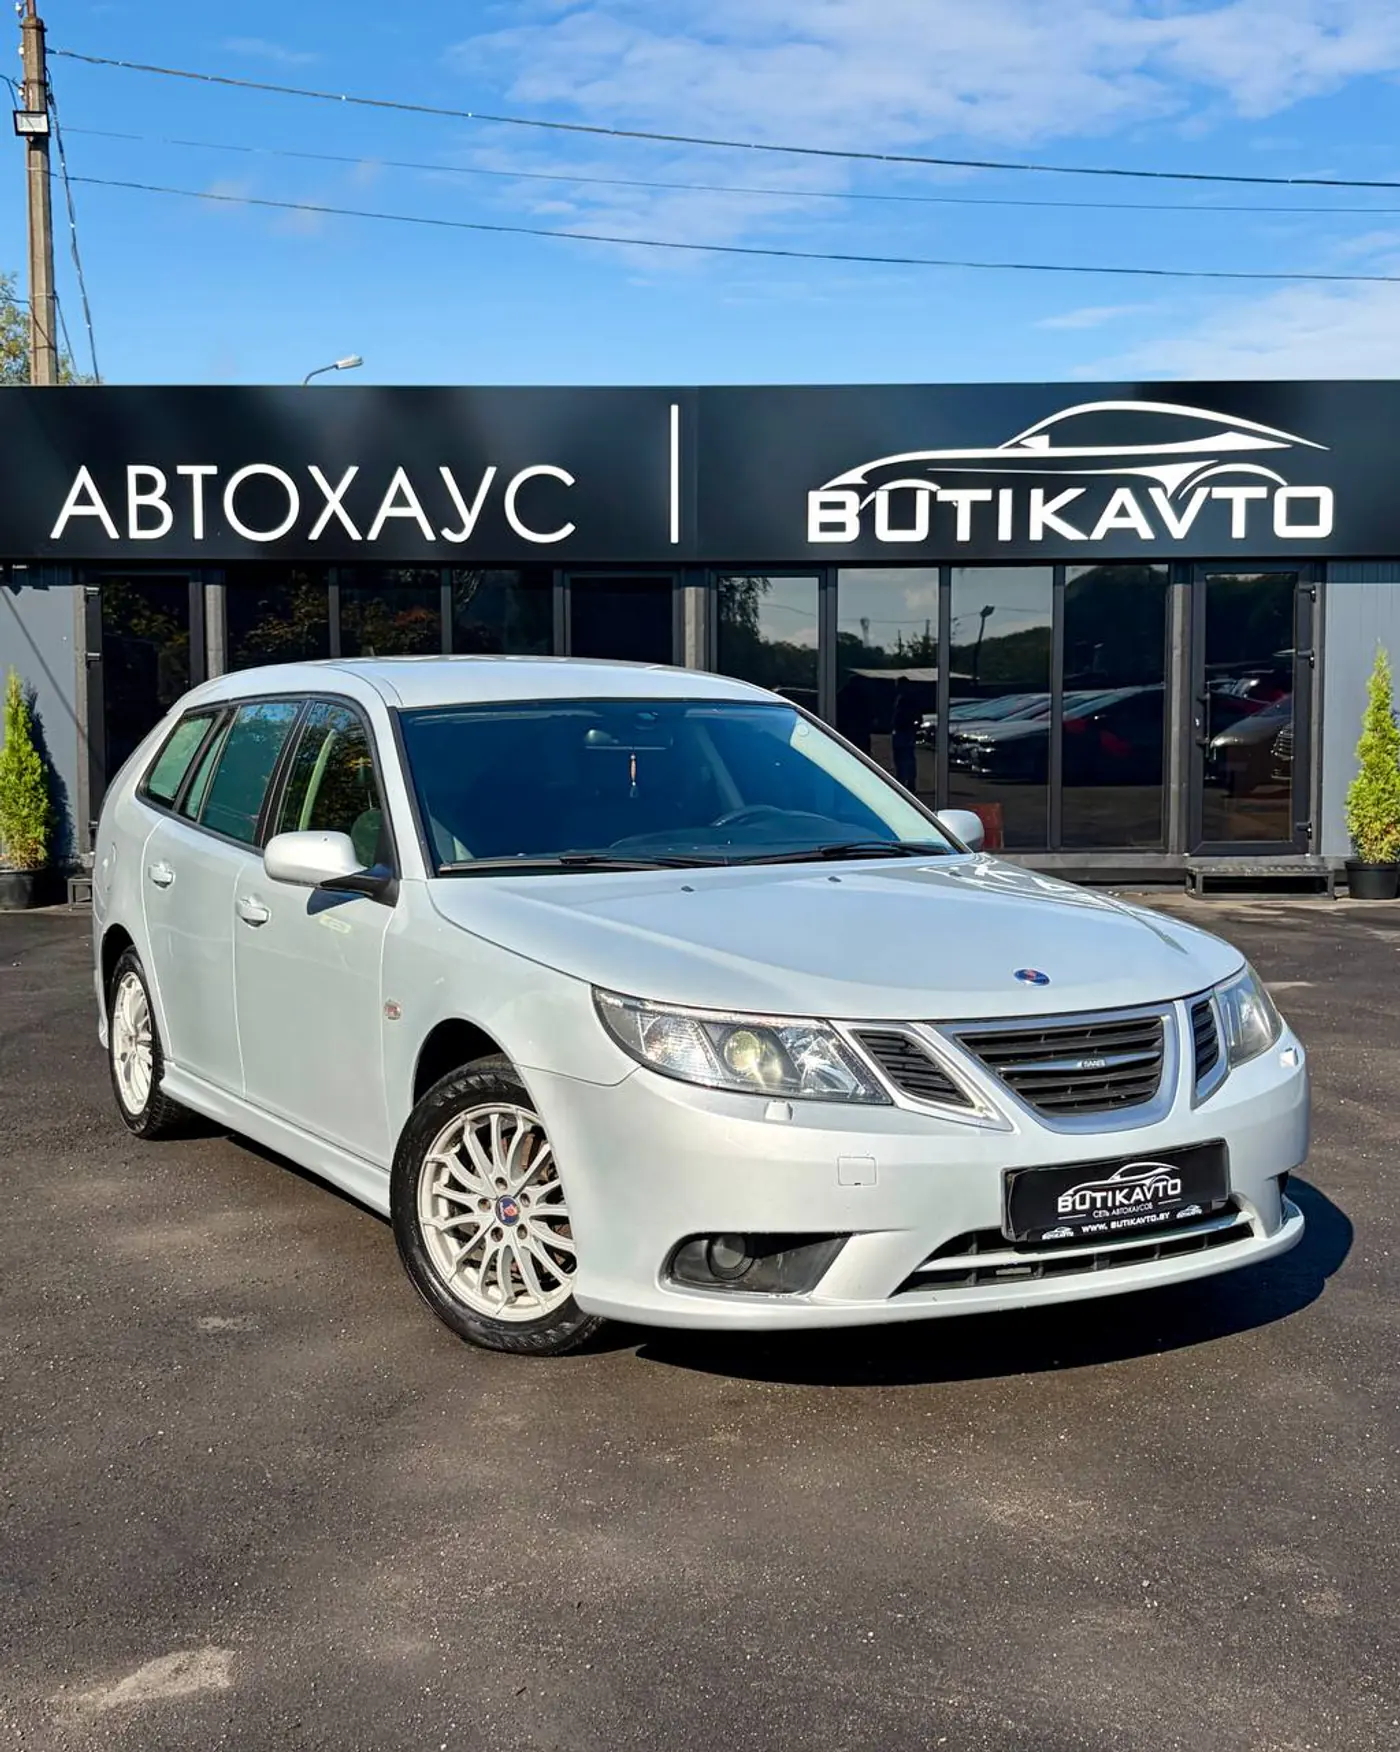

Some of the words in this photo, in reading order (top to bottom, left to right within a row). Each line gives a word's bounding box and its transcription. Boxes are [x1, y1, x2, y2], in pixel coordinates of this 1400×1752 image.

[50, 463, 576, 543] АВТОХАУС
[807, 485, 1334, 543] BUTIKAVTO
[1057, 1178, 1182, 1213] BUTIKAVTO
